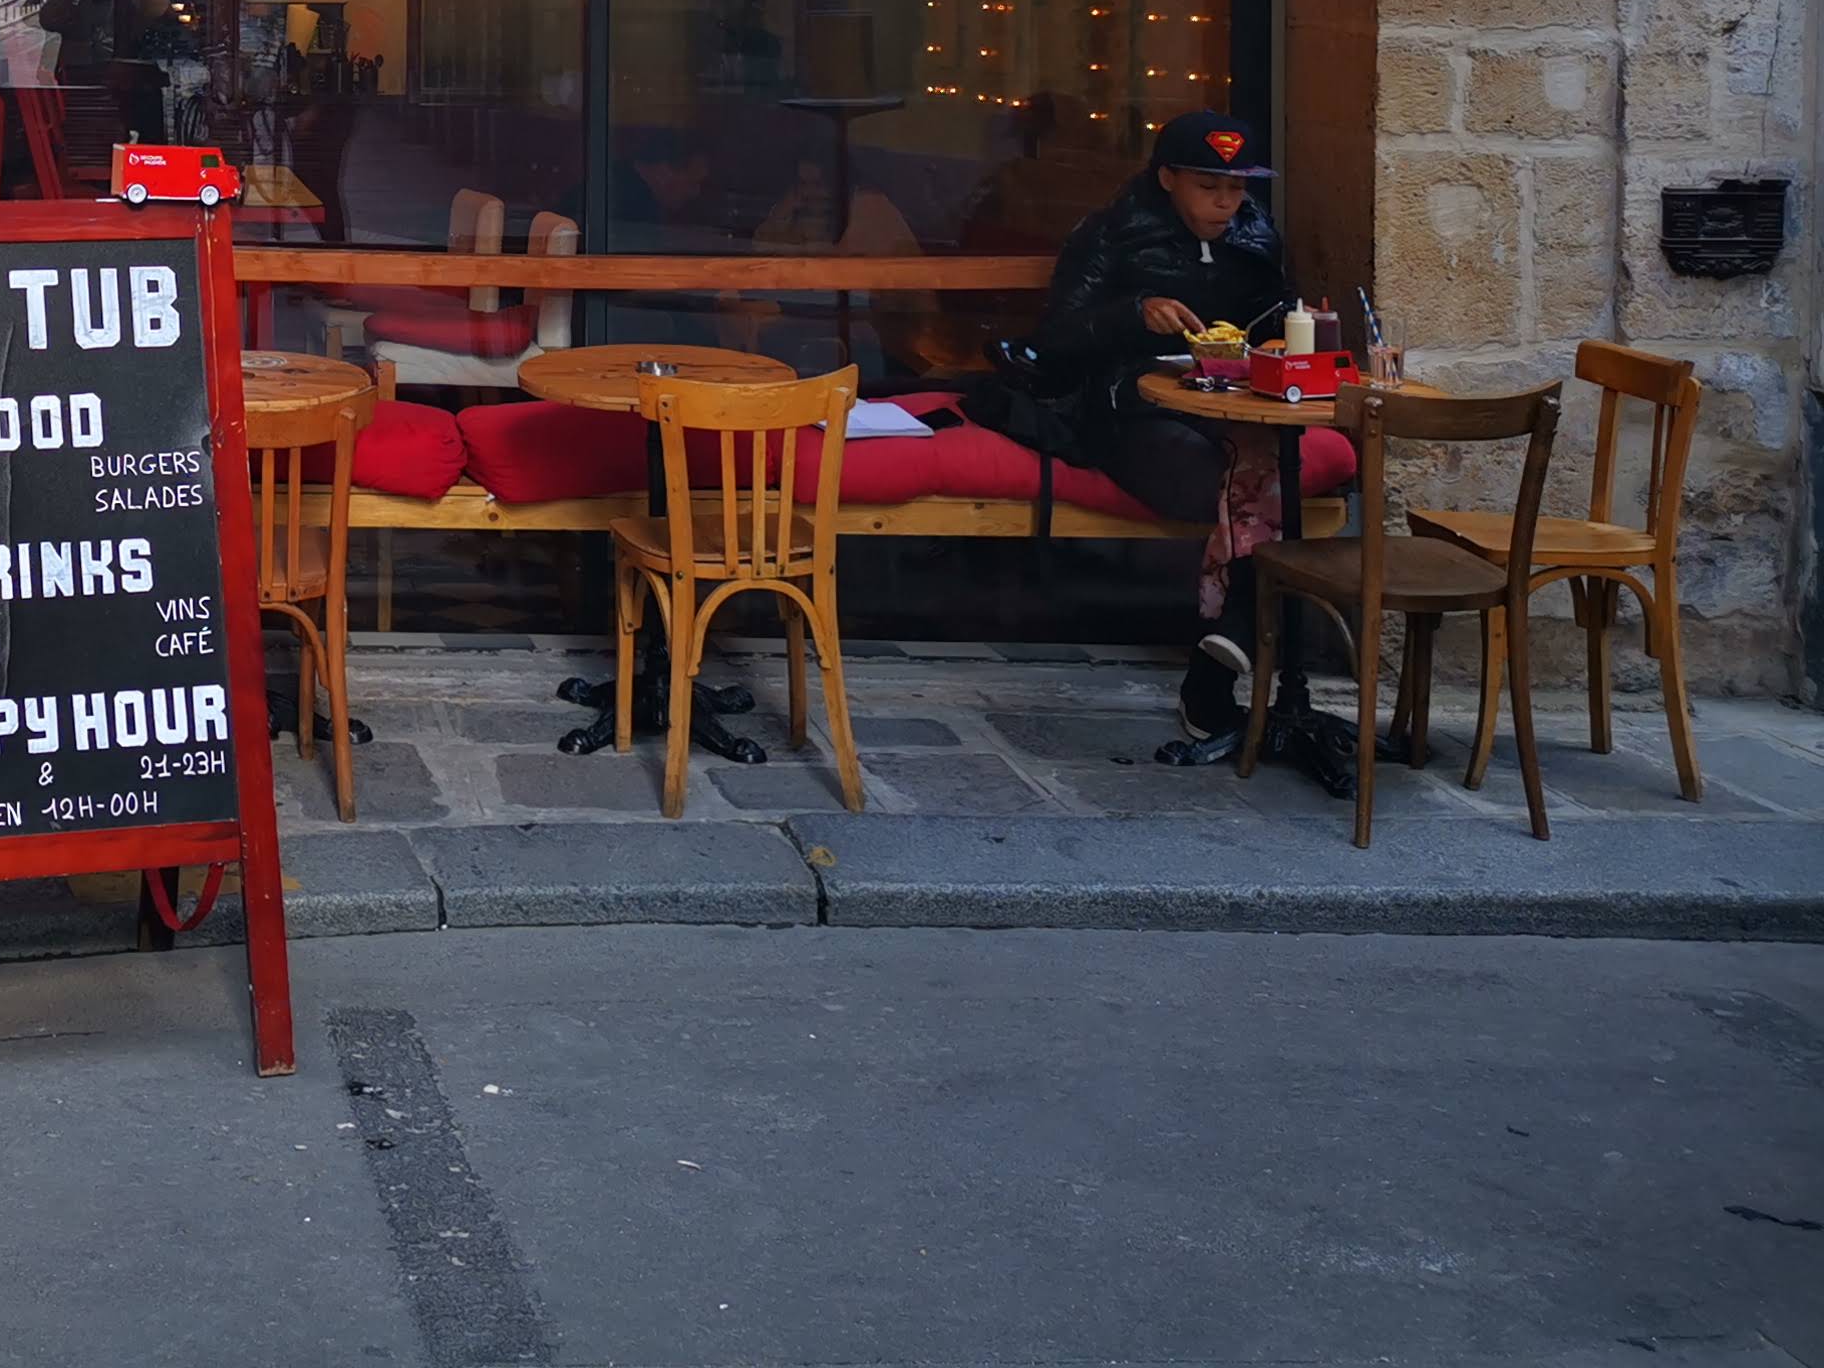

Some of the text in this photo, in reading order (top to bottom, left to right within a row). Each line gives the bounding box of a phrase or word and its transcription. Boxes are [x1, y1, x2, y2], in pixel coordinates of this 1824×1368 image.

[8, 265, 181, 350] TUB
[90, 451, 201, 478] BURGERS
[95, 484, 203, 512] SALADES
[156, 595, 211, 622] VINS
[155, 627, 214, 657] CAFÉ
[71, 684, 228, 751] HOUR
[38, 761, 54, 786] &
[140, 750, 226, 779] 21-23H
[41, 790, 157, 820] 12H-00H
